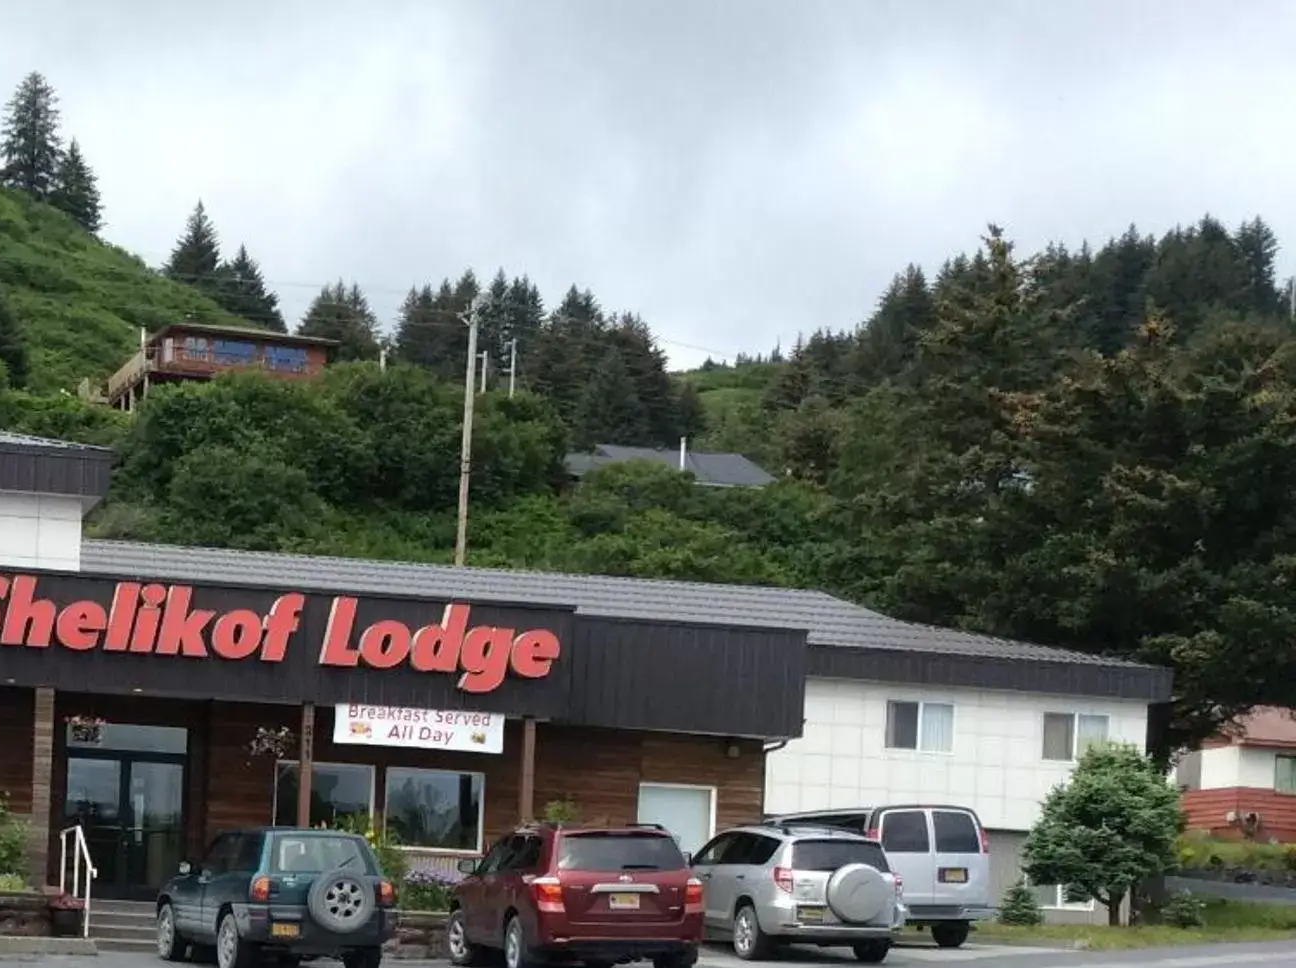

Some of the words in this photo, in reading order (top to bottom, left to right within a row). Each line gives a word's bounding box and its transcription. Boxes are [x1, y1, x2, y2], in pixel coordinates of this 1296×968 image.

[319, 596, 561, 694] Lodge
[348, 704, 429, 723] Breakfast
[435, 709, 491, 727] Served
[387, 724, 414, 740] All
[418, 726, 455, 745] Day
